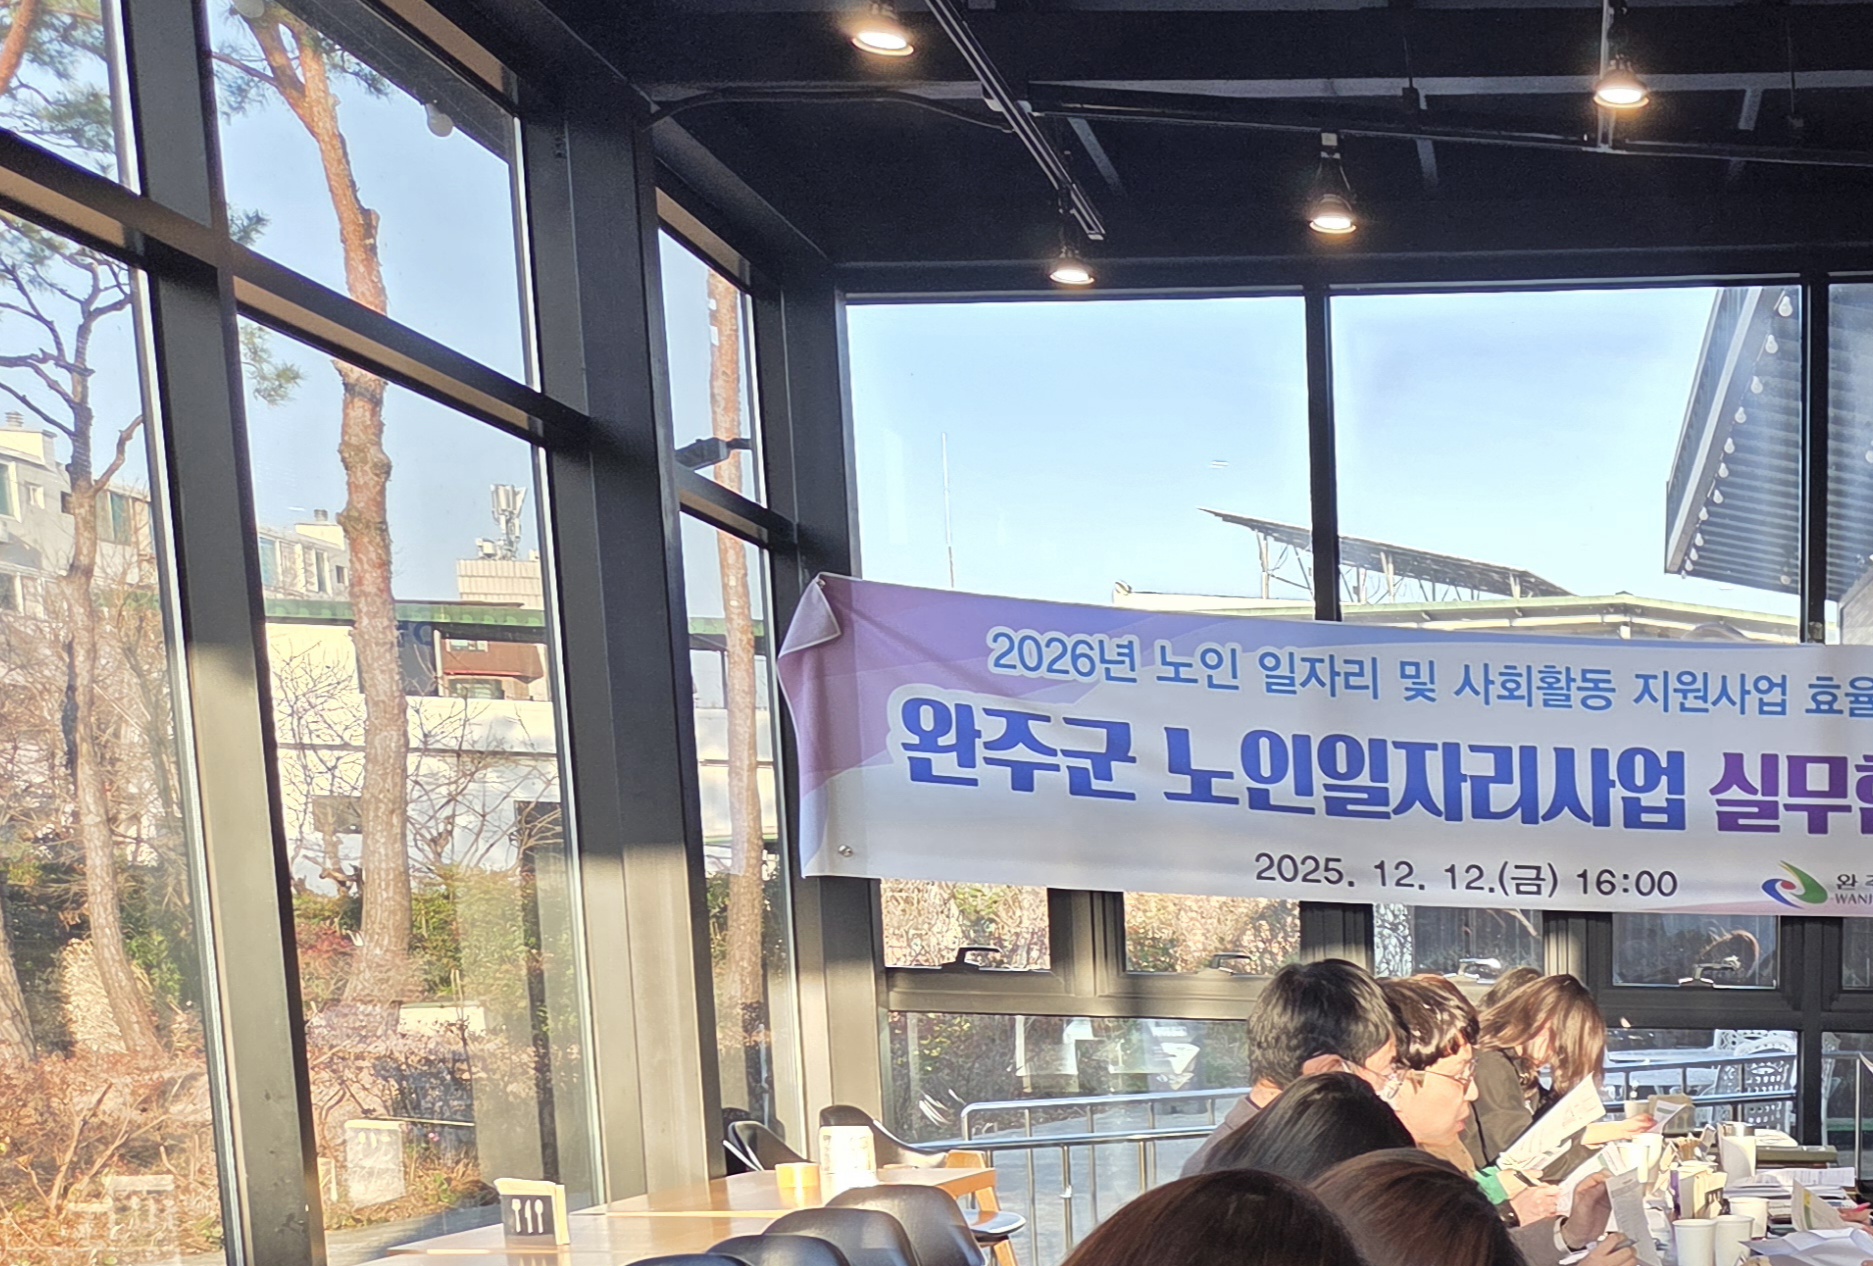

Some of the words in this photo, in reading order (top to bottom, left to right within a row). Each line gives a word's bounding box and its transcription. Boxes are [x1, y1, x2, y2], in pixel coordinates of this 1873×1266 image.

[992, 632, 1137, 684] 2026년
[1156, 645, 1239, 691] 노인
[1258, 651, 1379, 699] 일자리
[1400, 661, 1437, 703] 및
[1453, 663, 1616, 711] 사회활동
[1632, 670, 1788, 716] 지원사업
[902, 697, 1136, 801] 완주군
[1163, 727, 1686, 831] 노인일자리사업
[1255, 852, 1355, 888] 2025.
[1374, 860, 1425, 891] 12.
[1444, 861, 1558, 898] 12.(금)
[1575, 868, 1678, 897] 16:00
